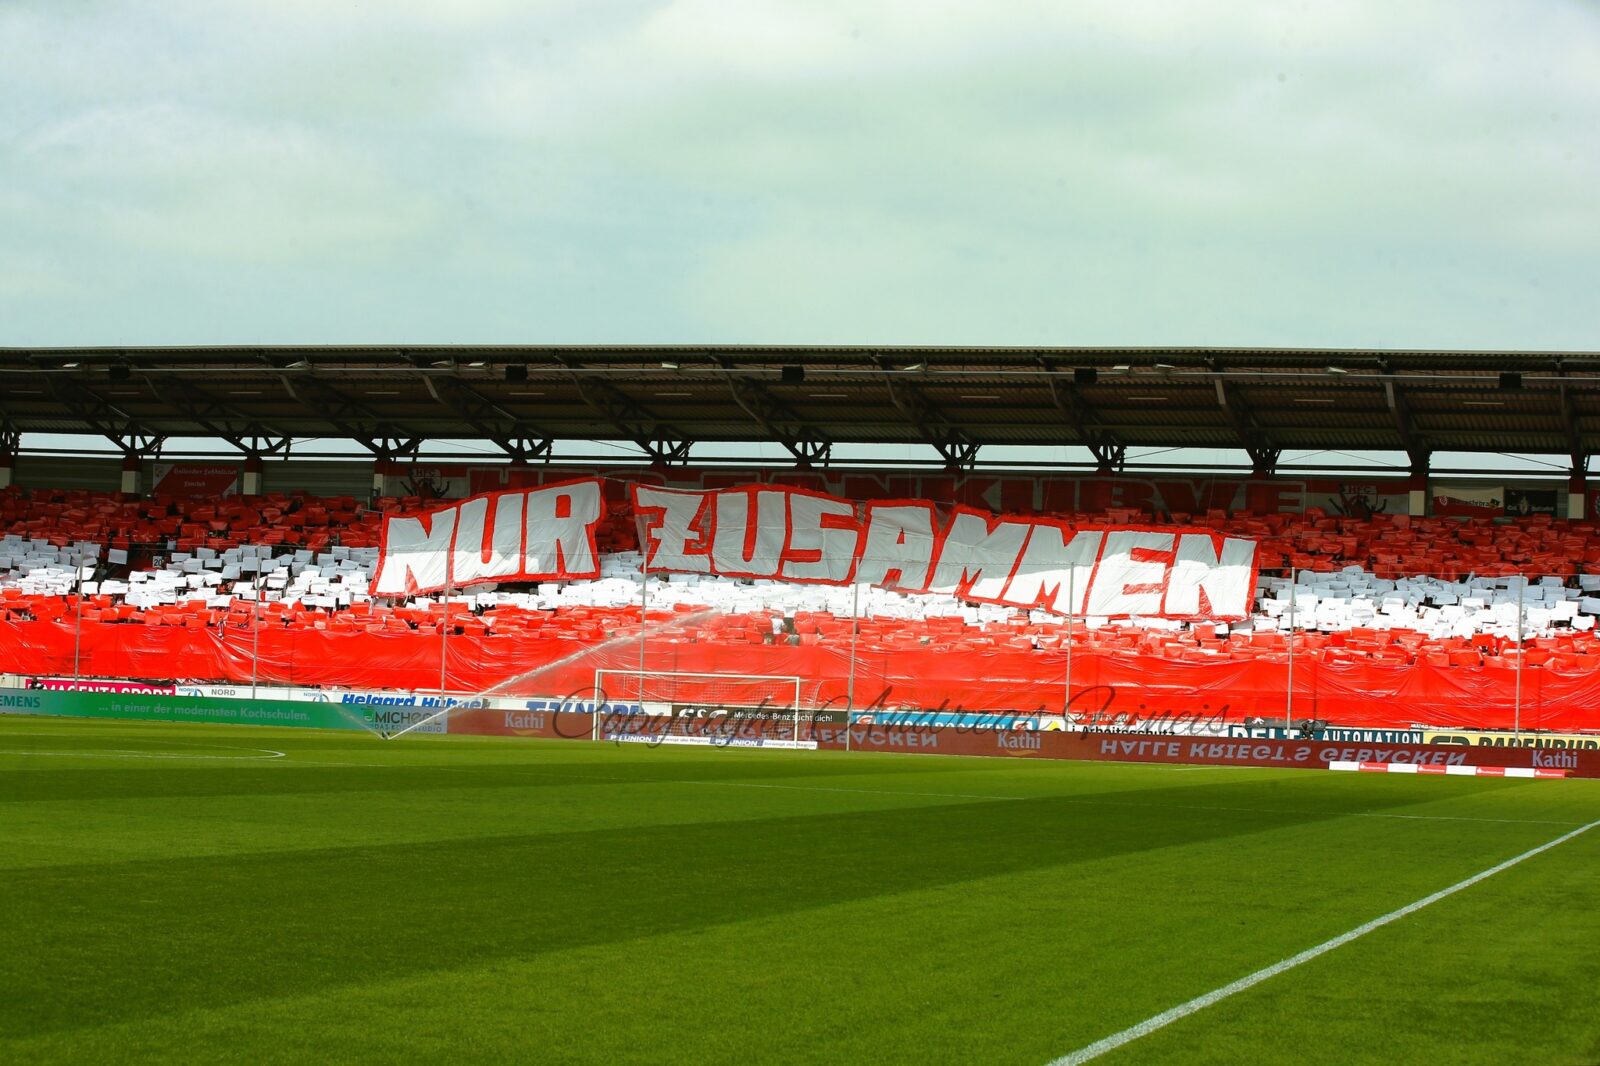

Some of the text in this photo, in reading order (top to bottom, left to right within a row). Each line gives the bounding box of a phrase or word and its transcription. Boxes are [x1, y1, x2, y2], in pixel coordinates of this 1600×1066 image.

[374, 481, 600, 594] NUR
[634, 489, 1258, 618] ZUSAMMEN
[111, 703, 121, 711] in
[124, 703, 151, 712] einer
[154, 704, 173, 713] der
[175, 705, 237, 716] modernsten
[240, 707, 310, 720] Kochschulen.
[504, 711, 544, 729] Kathi
[734, 711, 833, 722] Mercedes-Benz sucht dich!
[997, 730, 1041, 748] Kathi
[1322, 730, 1421, 744] AUTOMATION
[1532, 749, 1578, 768] Kathi
